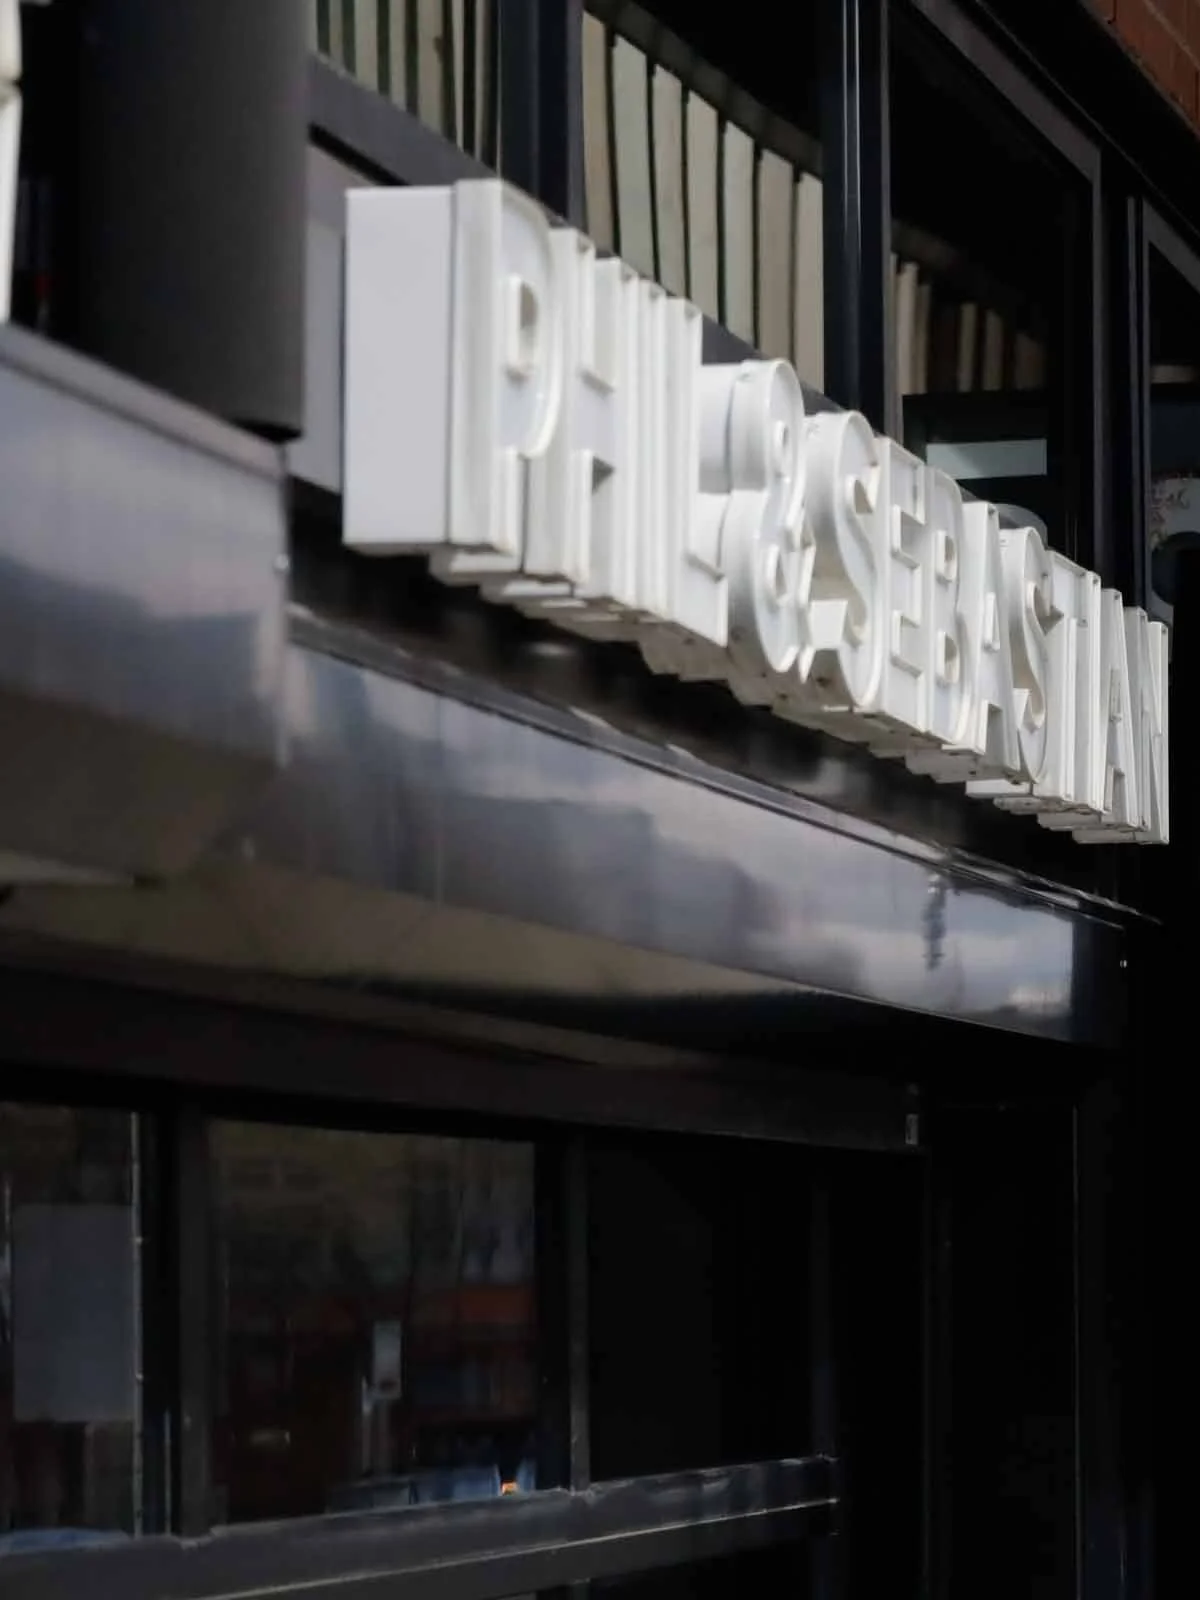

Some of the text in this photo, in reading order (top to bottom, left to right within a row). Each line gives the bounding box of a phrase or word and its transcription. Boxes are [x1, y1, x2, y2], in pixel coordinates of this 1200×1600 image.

[346, 179, 1169, 845] PHIL & SEBASTIAN
